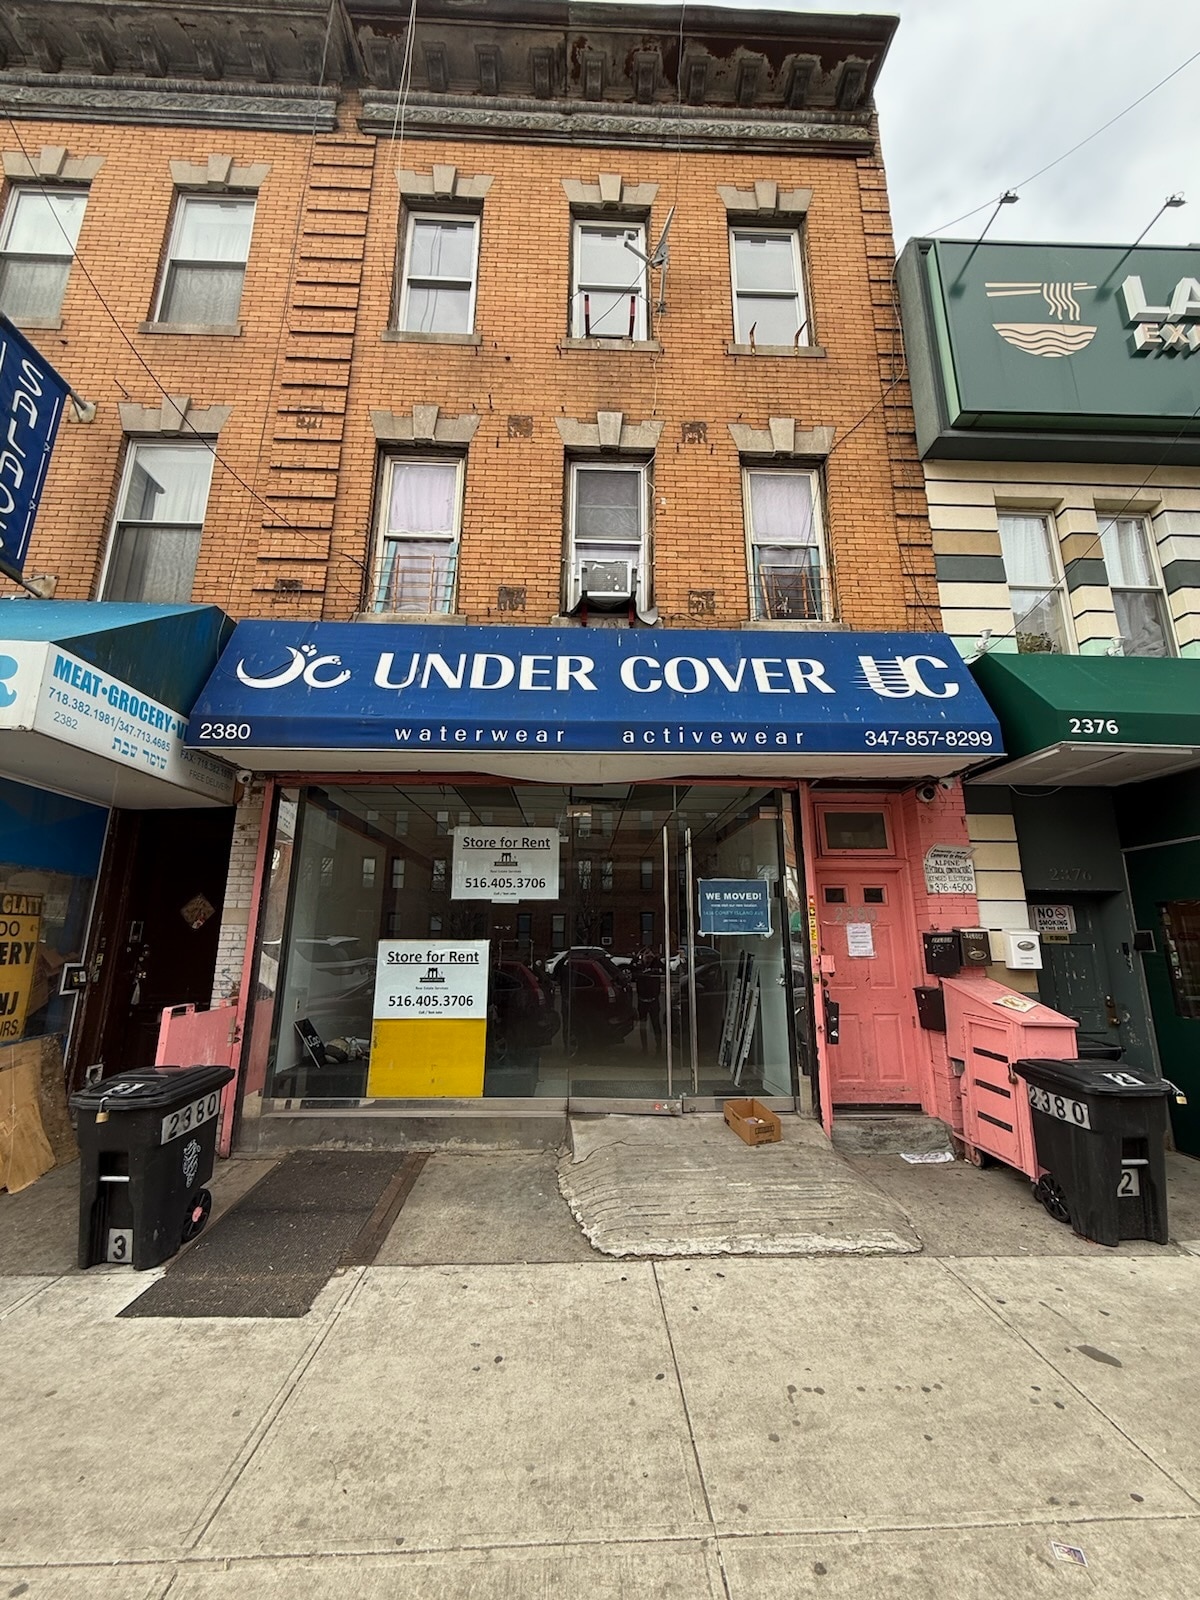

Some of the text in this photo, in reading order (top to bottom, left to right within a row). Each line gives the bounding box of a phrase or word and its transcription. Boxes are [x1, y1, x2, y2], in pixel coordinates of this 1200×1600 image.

[373, 652, 598, 691] UNDER
[620, 655, 836, 694] COVER
[53, 711, 79, 730] 2382
[1069, 718, 1119, 735] 2376
[199, 723, 251, 740] 2380
[395, 726, 804, 744] waterwear activewear
[864, 730, 993, 747] 347-857-8299
[463, 836, 550, 848] Store for Rent
[465, 877, 546, 889] 516.405.3706
[2, 895, 41, 914] GLATT
[705, 892, 762, 900] WE MOVED!
[1037, 907, 1054, 918] NO
[387, 951, 479, 963] Store for Rent
[388, 995, 474, 1007] 516.405.3706
[1029, 1086, 1085, 1125] 2380
[168, 1093, 217, 1139] 2380
[1120, 1171, 1134, 1194] 2
[112, 1234, 127, 1260] 3
